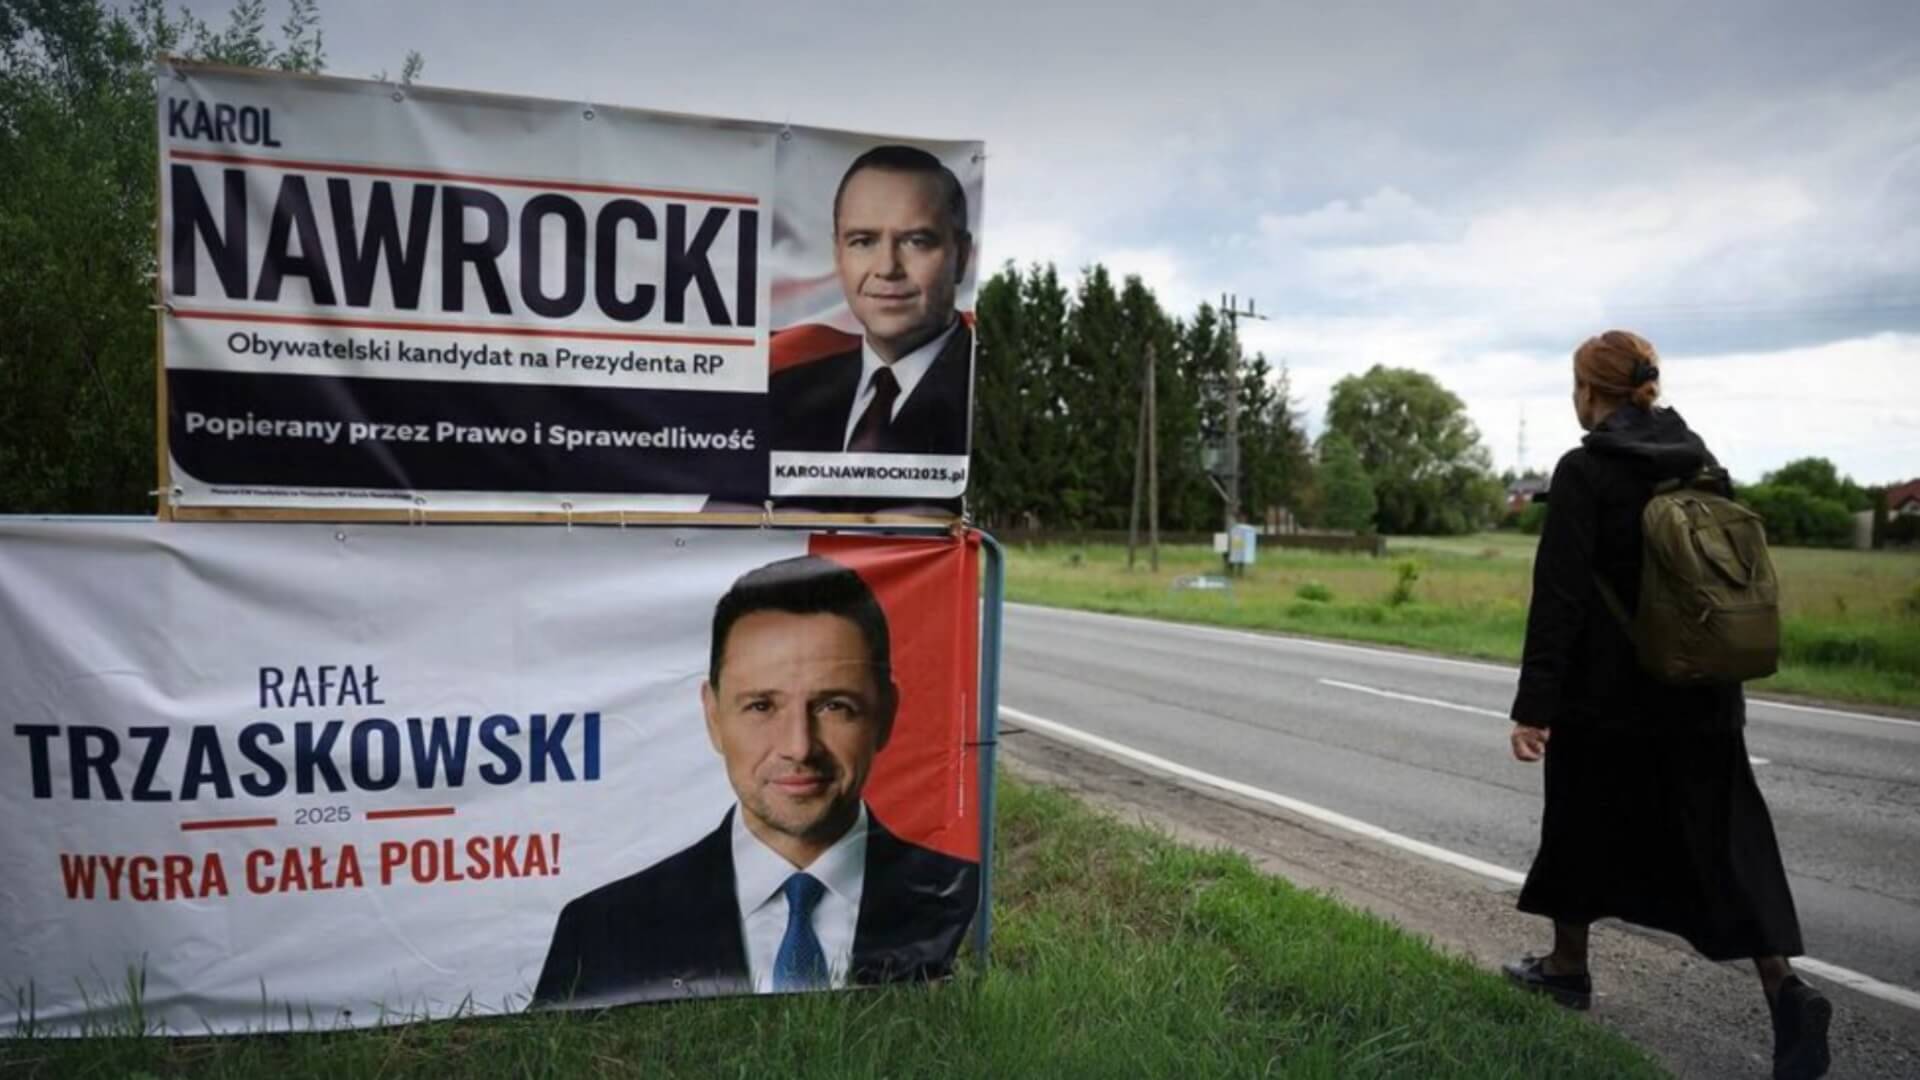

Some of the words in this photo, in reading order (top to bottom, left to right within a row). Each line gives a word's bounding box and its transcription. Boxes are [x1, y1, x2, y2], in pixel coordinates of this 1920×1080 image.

[168, 97, 281, 147] KAROL
[171, 164, 758, 328] NAWROCKI
[228, 332, 390, 361] Obywatelski
[398, 340, 512, 369] kandydat
[520, 351, 548, 368] na
[556, 349, 687, 375] Prezydenta
[693, 355, 724, 374] RP
[186, 412, 341, 443] Popierany
[351, 420, 429, 444] przez
[436, 421, 527, 444] Prawo
[534, 422, 541, 444] i
[775, 465, 965, 483] KAROLNAWROCKI2025.pl
[259, 665, 385, 708] RAFAŁ
[14, 711, 601, 801] TRZASKOWSKI
[294, 806, 352, 825] 2025
[60, 853, 228, 901] WYGRA
[245, 844, 363, 894] CAŁA
[380, 833, 560, 885] POLSKA!
